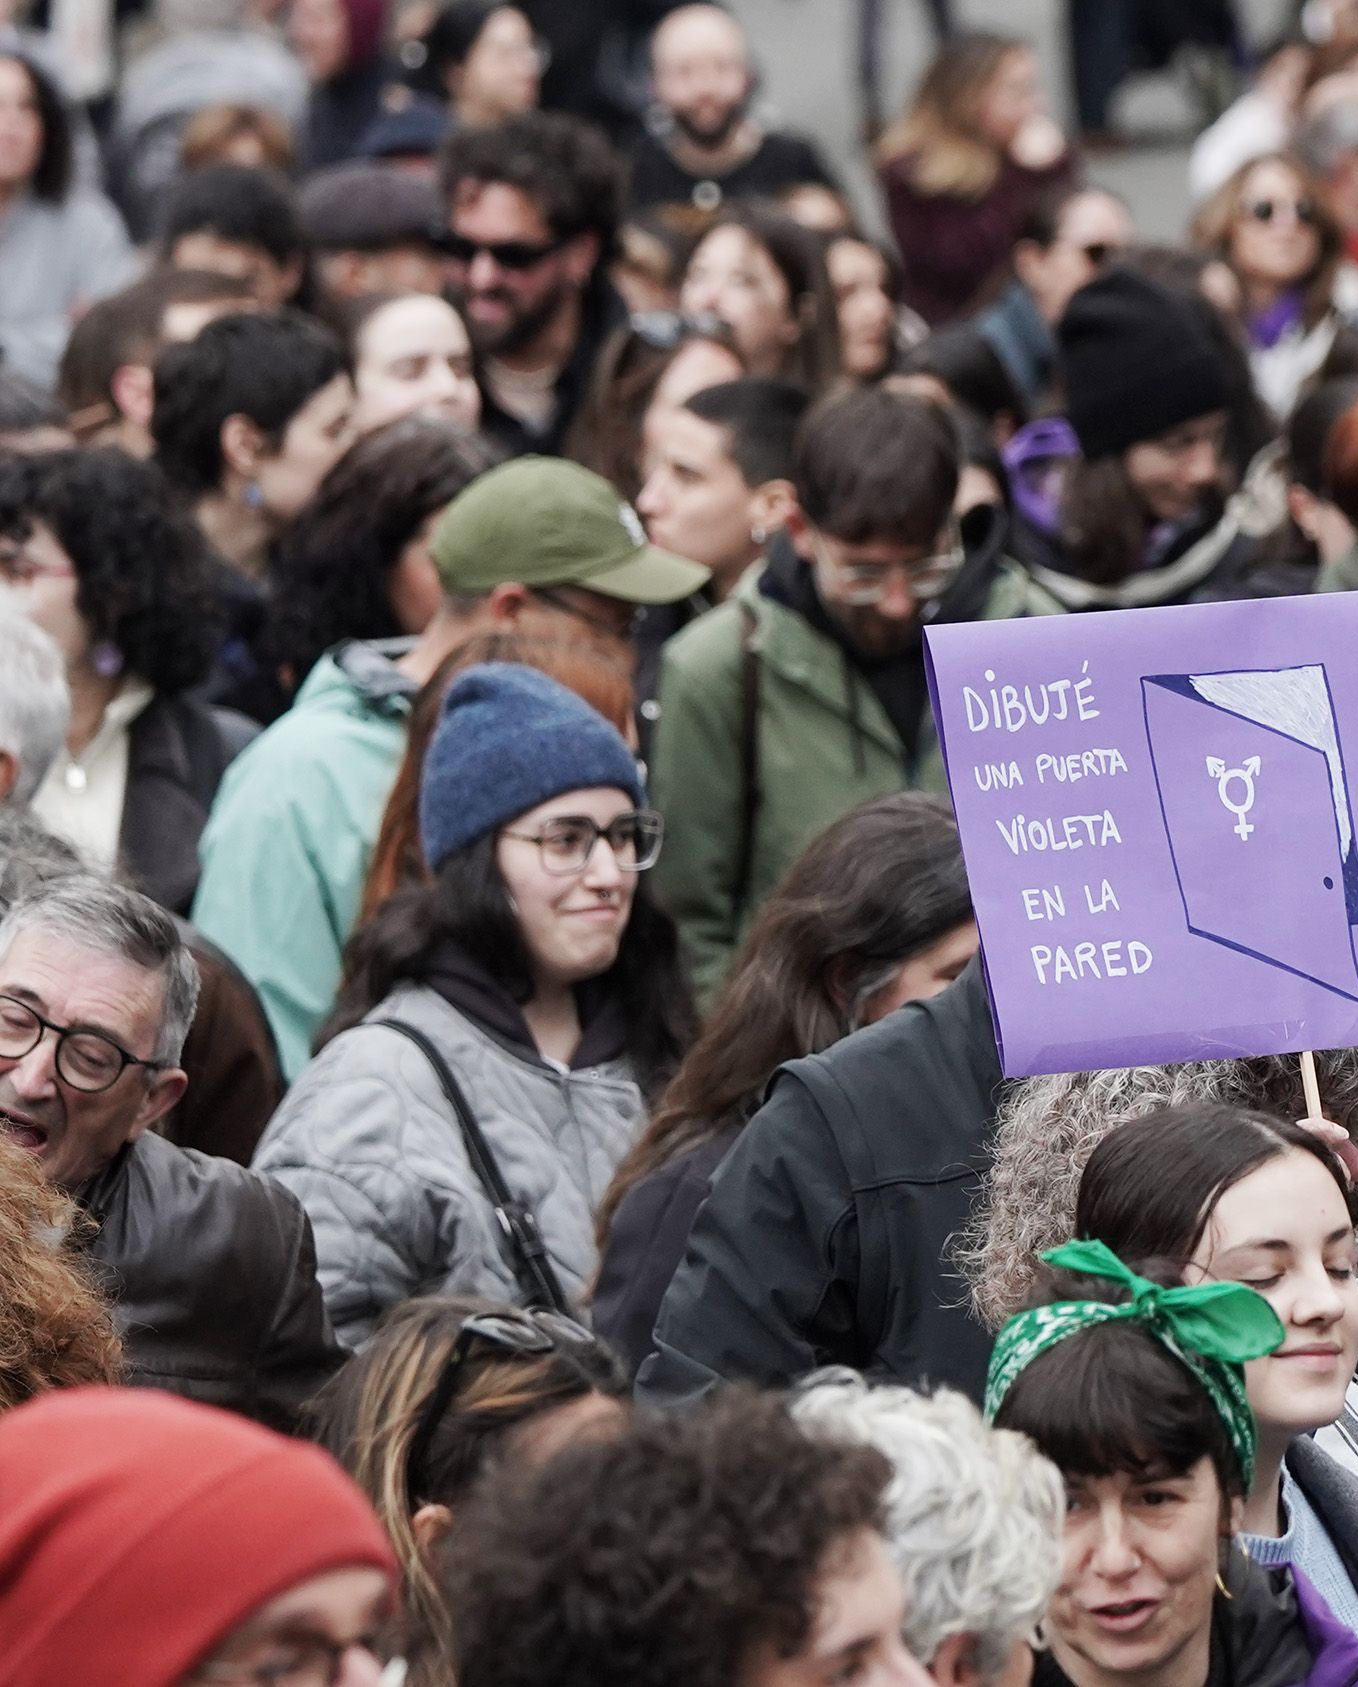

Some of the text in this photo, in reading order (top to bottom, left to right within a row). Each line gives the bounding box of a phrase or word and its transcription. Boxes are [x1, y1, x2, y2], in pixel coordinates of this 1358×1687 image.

[974, 748, 1129, 792] UNA PUERTA
[1021, 878, 1120, 921] EN LA
[1030, 940, 1153, 985] PARED
